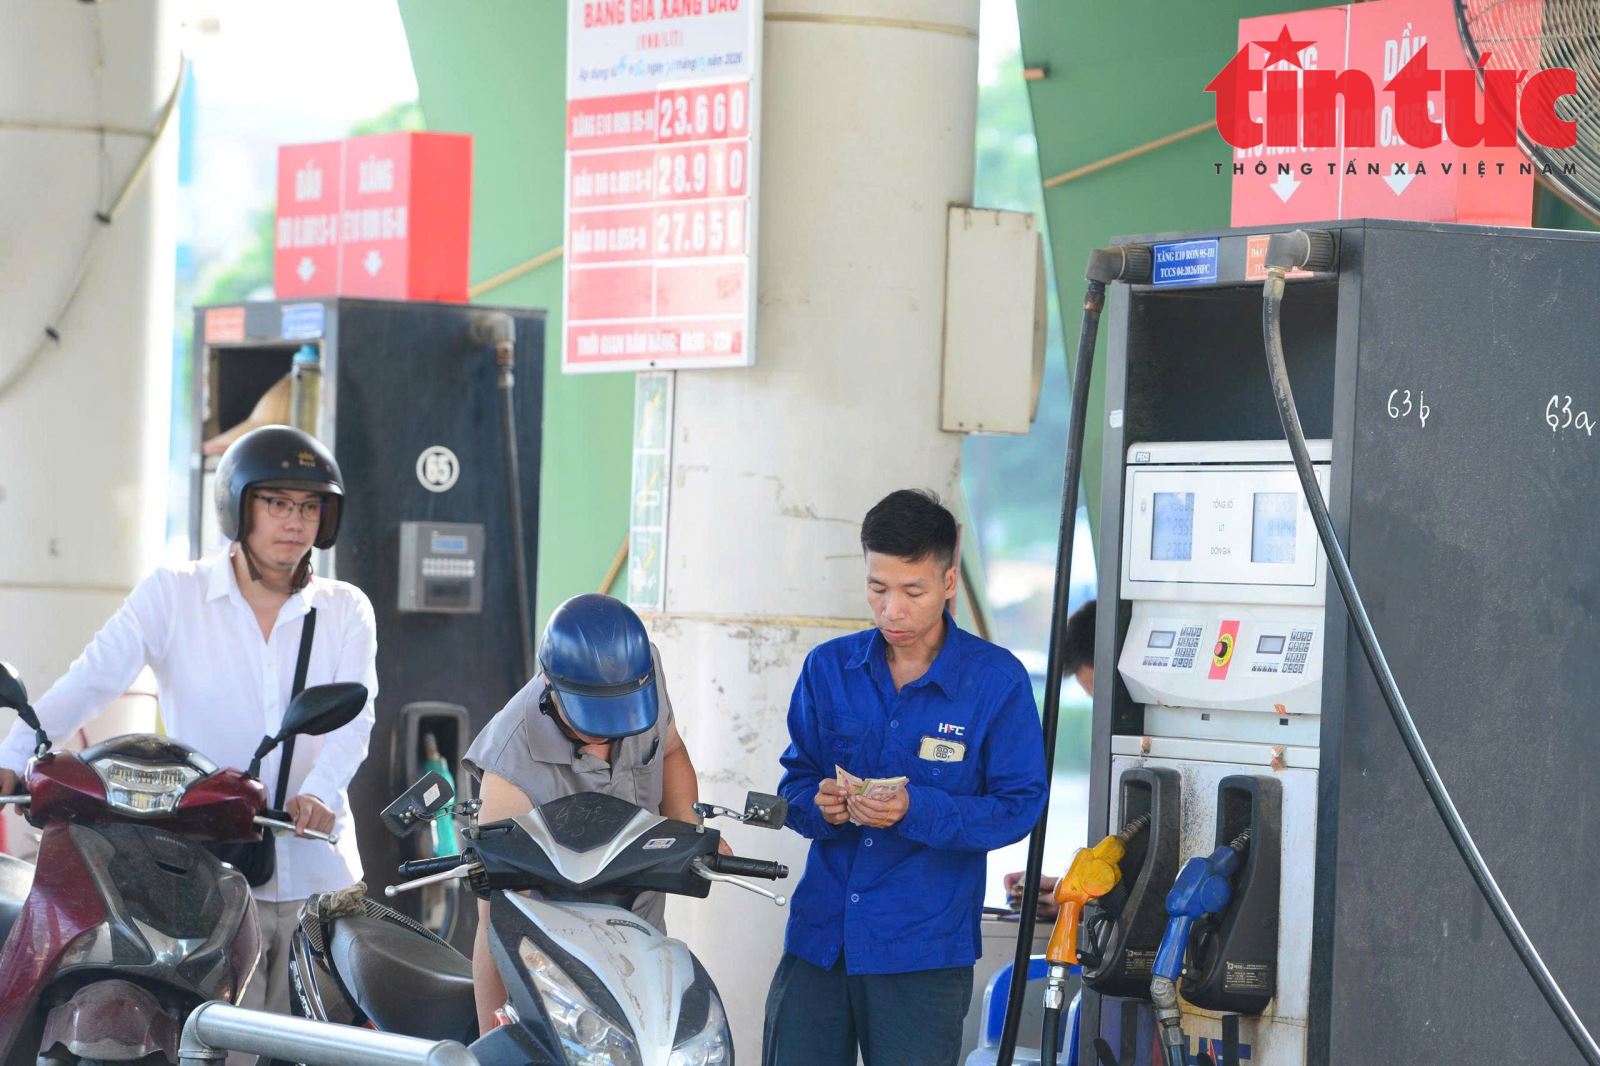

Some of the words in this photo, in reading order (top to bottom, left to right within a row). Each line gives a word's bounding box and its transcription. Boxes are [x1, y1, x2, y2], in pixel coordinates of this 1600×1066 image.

[659, 90, 745, 138] 23.660
[658, 150, 743, 195] 28.910
[658, 208, 740, 252] 27.650
